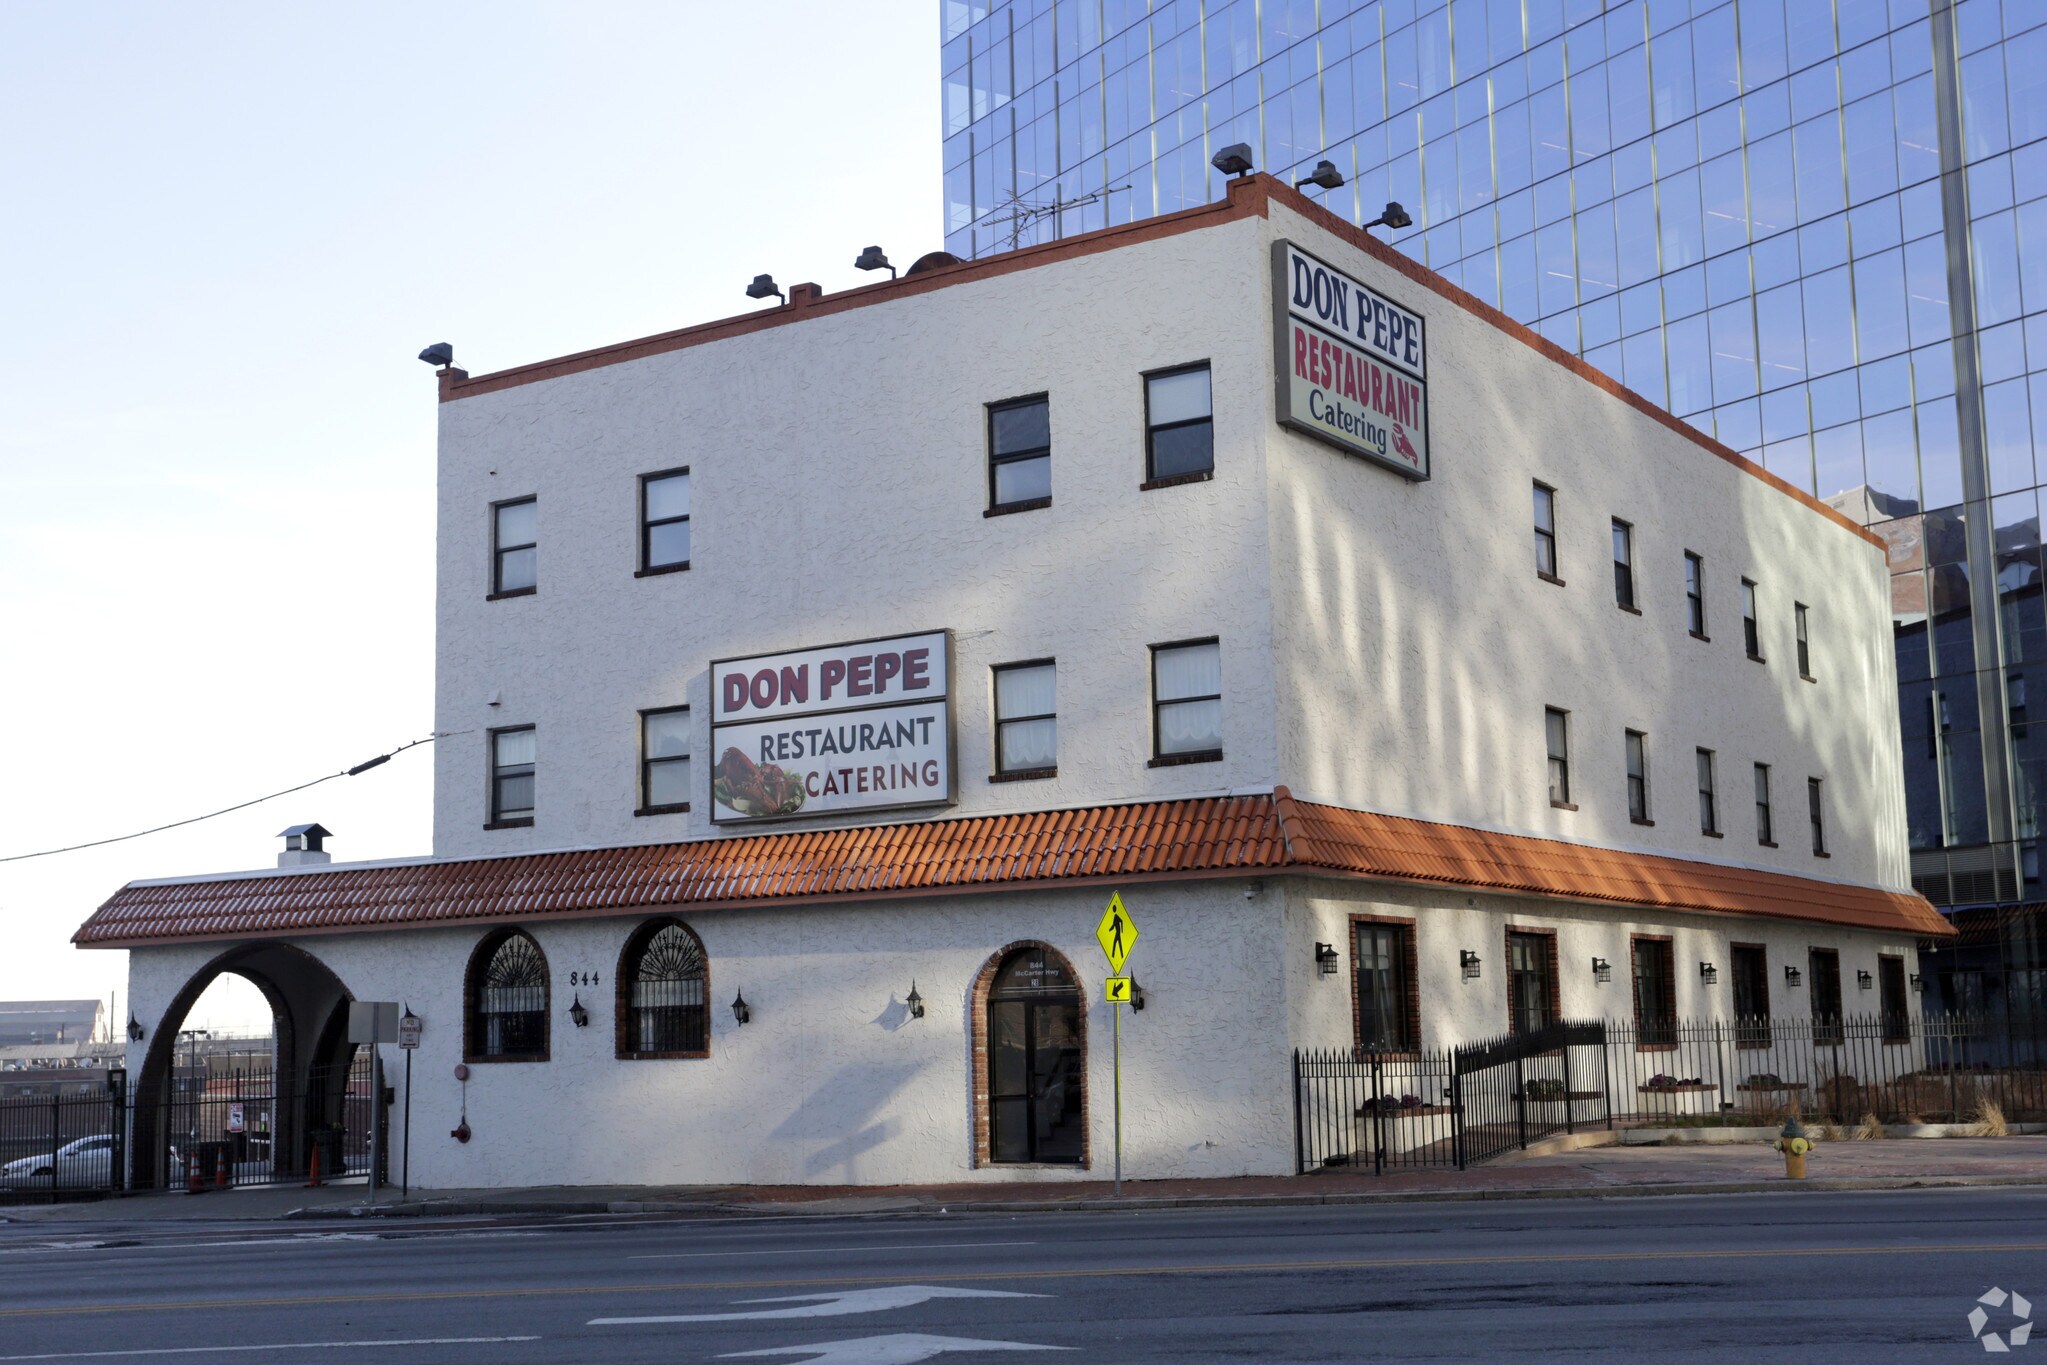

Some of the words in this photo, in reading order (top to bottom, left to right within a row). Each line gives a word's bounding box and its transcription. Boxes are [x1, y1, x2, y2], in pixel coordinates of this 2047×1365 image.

[1291, 253, 1349, 332] DON
[1355, 288, 1419, 368] PEPE
[1294, 325, 1420, 432] RESTAURANT
[1309, 388, 1387, 455] Catering
[723, 663, 809, 713] DON
[820, 647, 931, 701] PEPE
[760, 716, 935, 762] RESTAURANT
[804, 759, 939, 798] CATERING
[570, 970, 600, 986] 844
[1029, 961, 1044, 969] 844
[1045, 969, 1060, 977] Hwy
